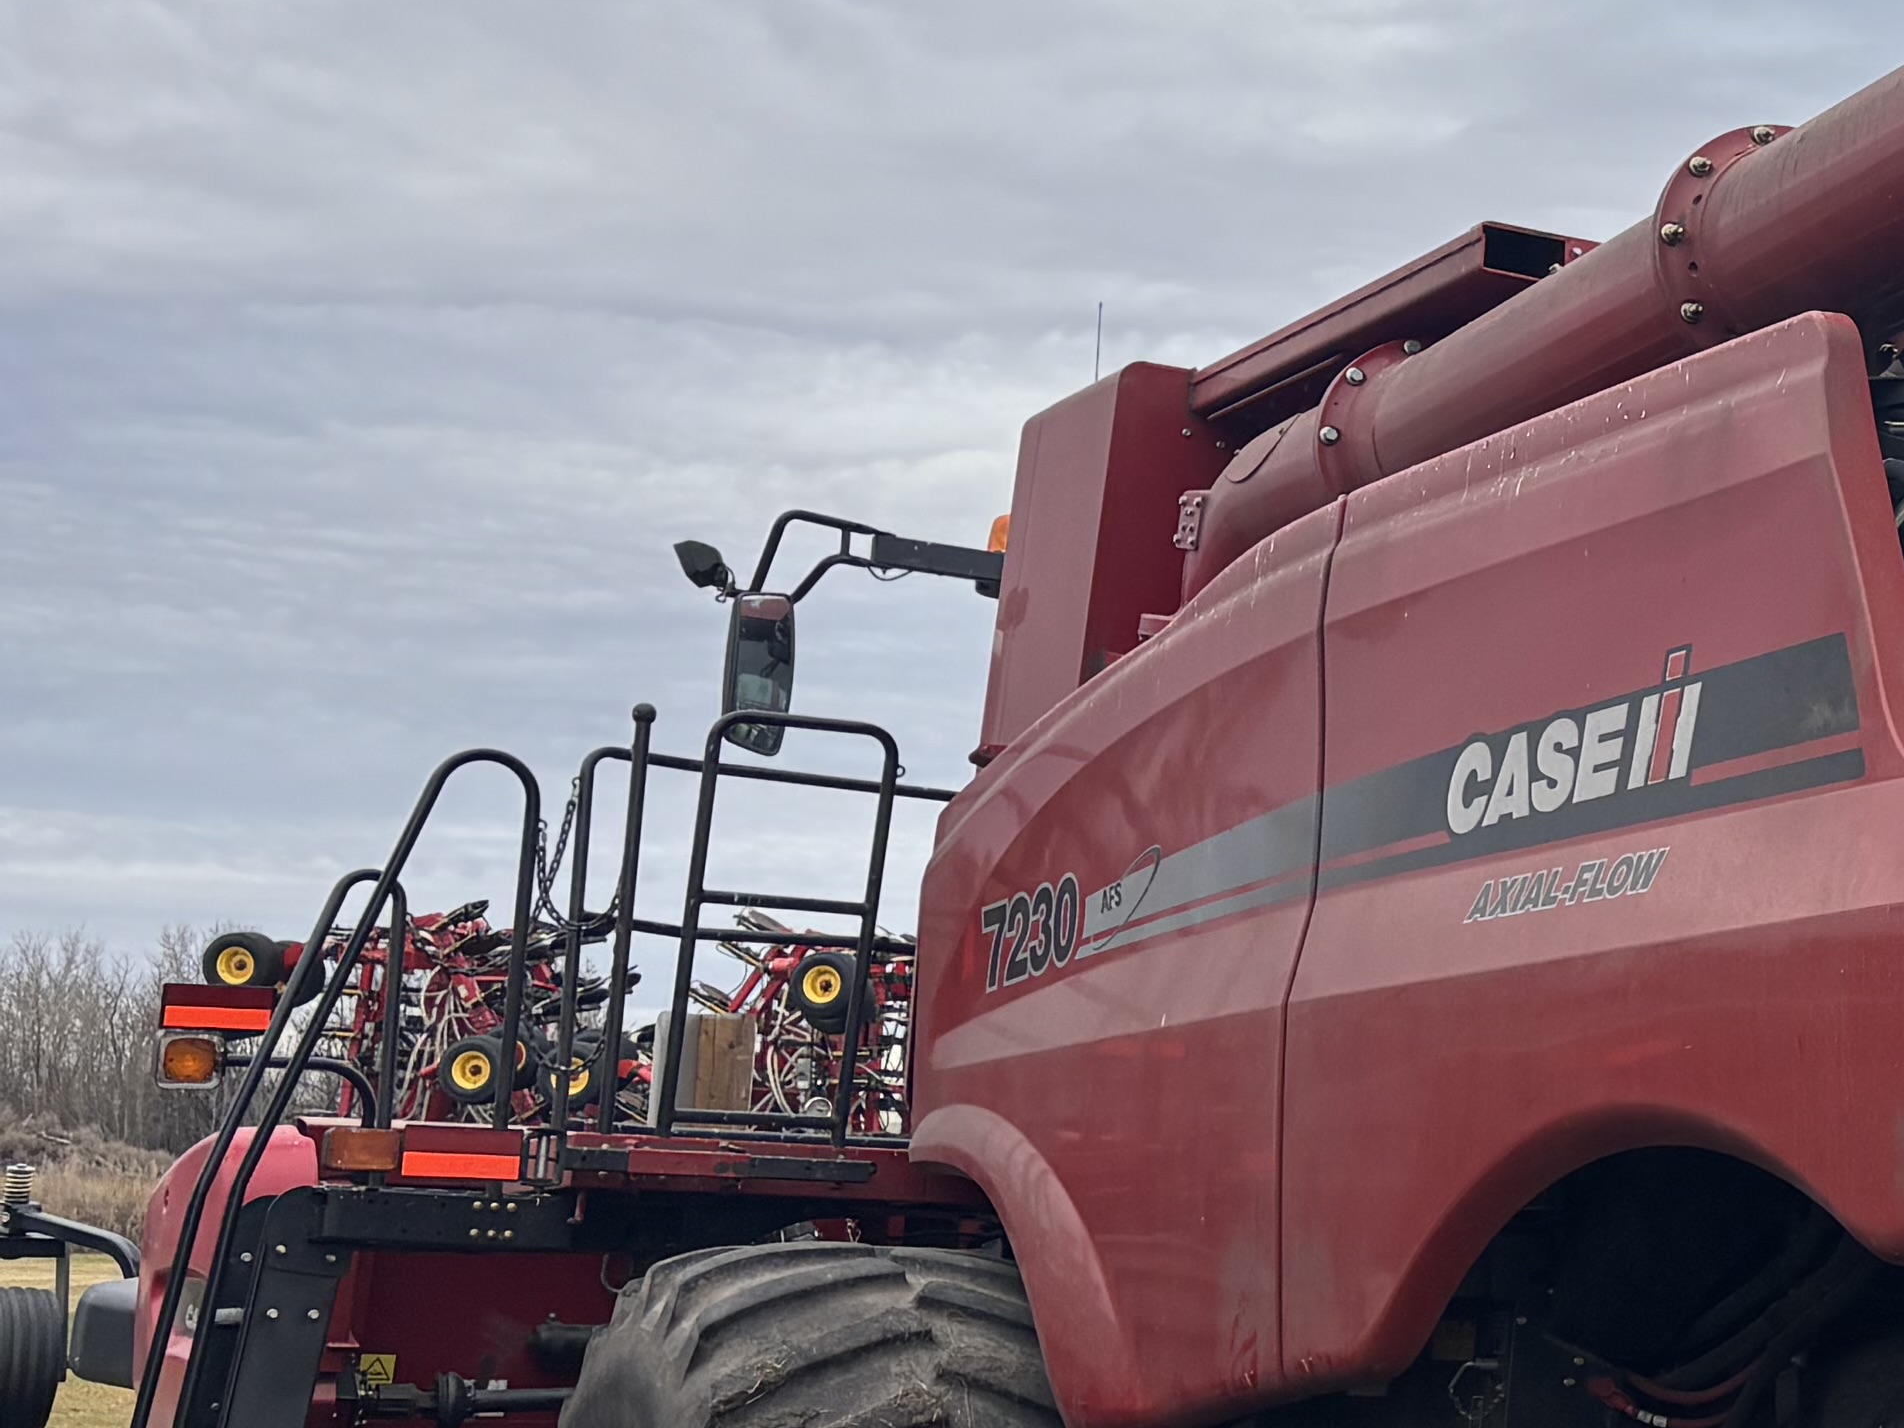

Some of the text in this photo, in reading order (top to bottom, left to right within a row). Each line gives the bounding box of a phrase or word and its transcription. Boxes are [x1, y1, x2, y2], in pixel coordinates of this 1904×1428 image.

[1447, 703, 1629, 835] CASE
[982, 872, 1079, 994] 7230
[1101, 882, 1122, 914] AFS
[1463, 846, 1670, 924] AXIAL-FLOW
